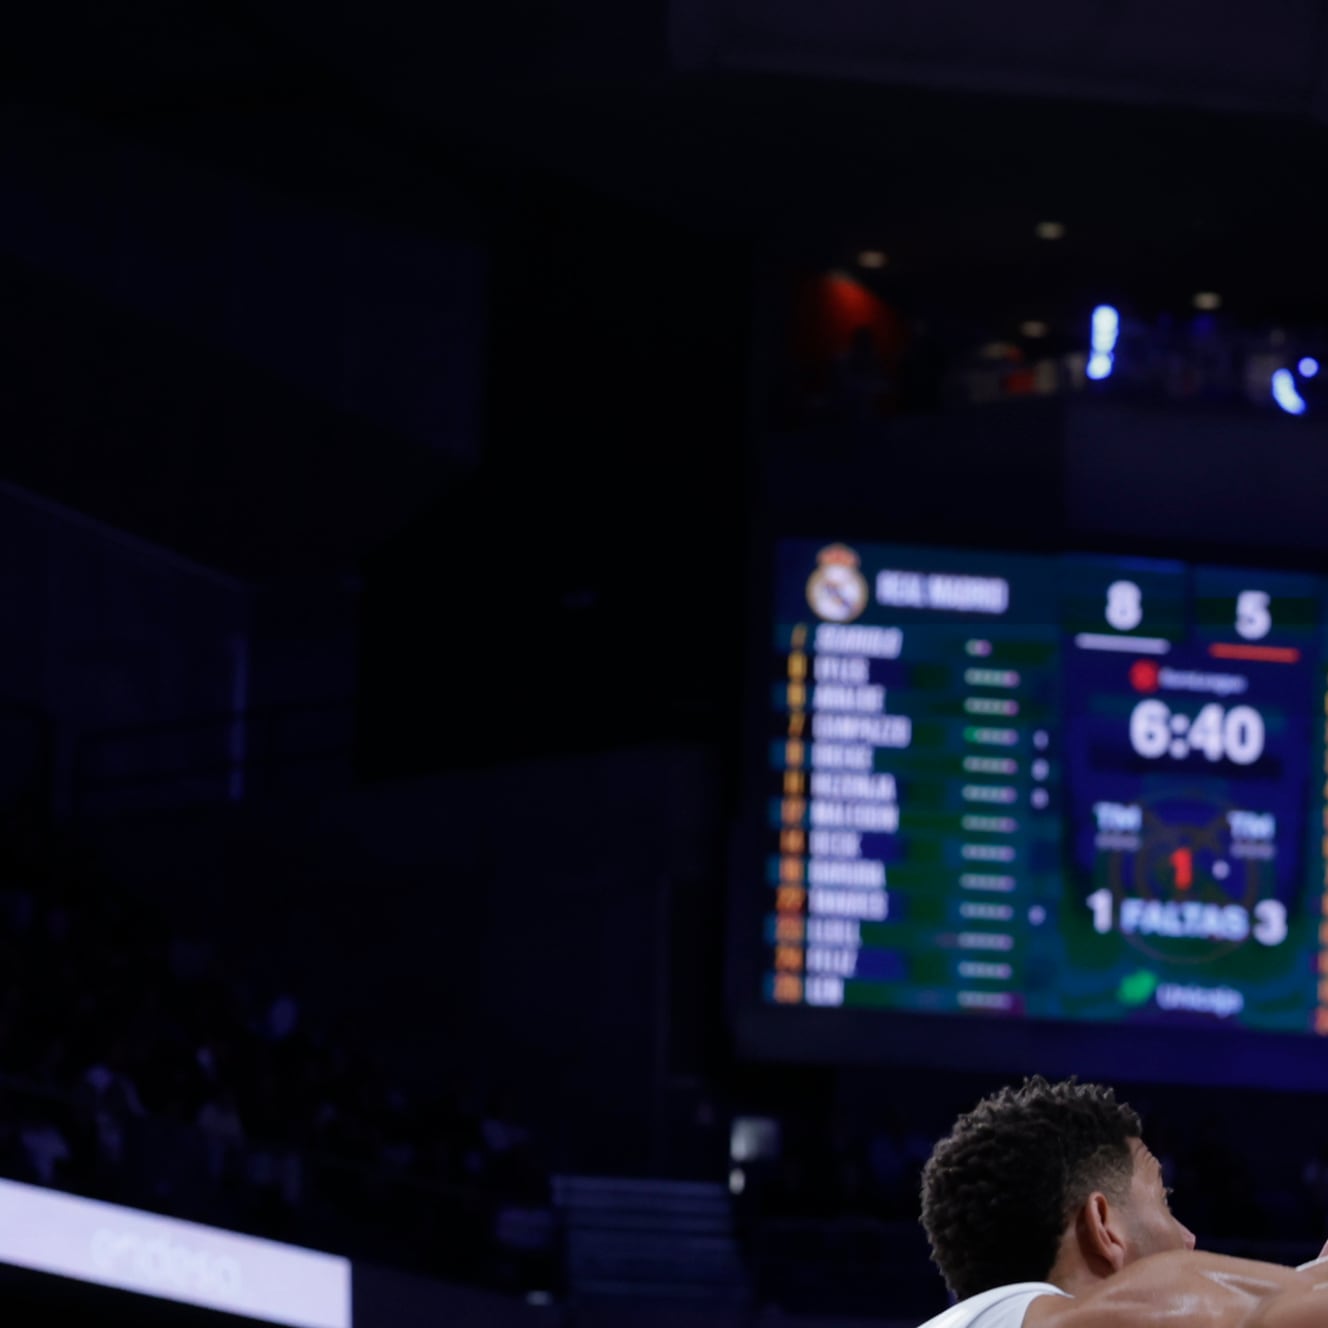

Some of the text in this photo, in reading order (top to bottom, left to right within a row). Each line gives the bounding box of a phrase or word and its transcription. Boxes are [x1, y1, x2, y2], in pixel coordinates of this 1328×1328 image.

[1105, 580, 1143, 630] 8
[1235, 590, 1272, 640] 5
[1129, 699, 1265, 765] 6:40
[1170, 847, 1193, 890] 1
[1087, 889, 1288, 946] 1 FALTAS 3
